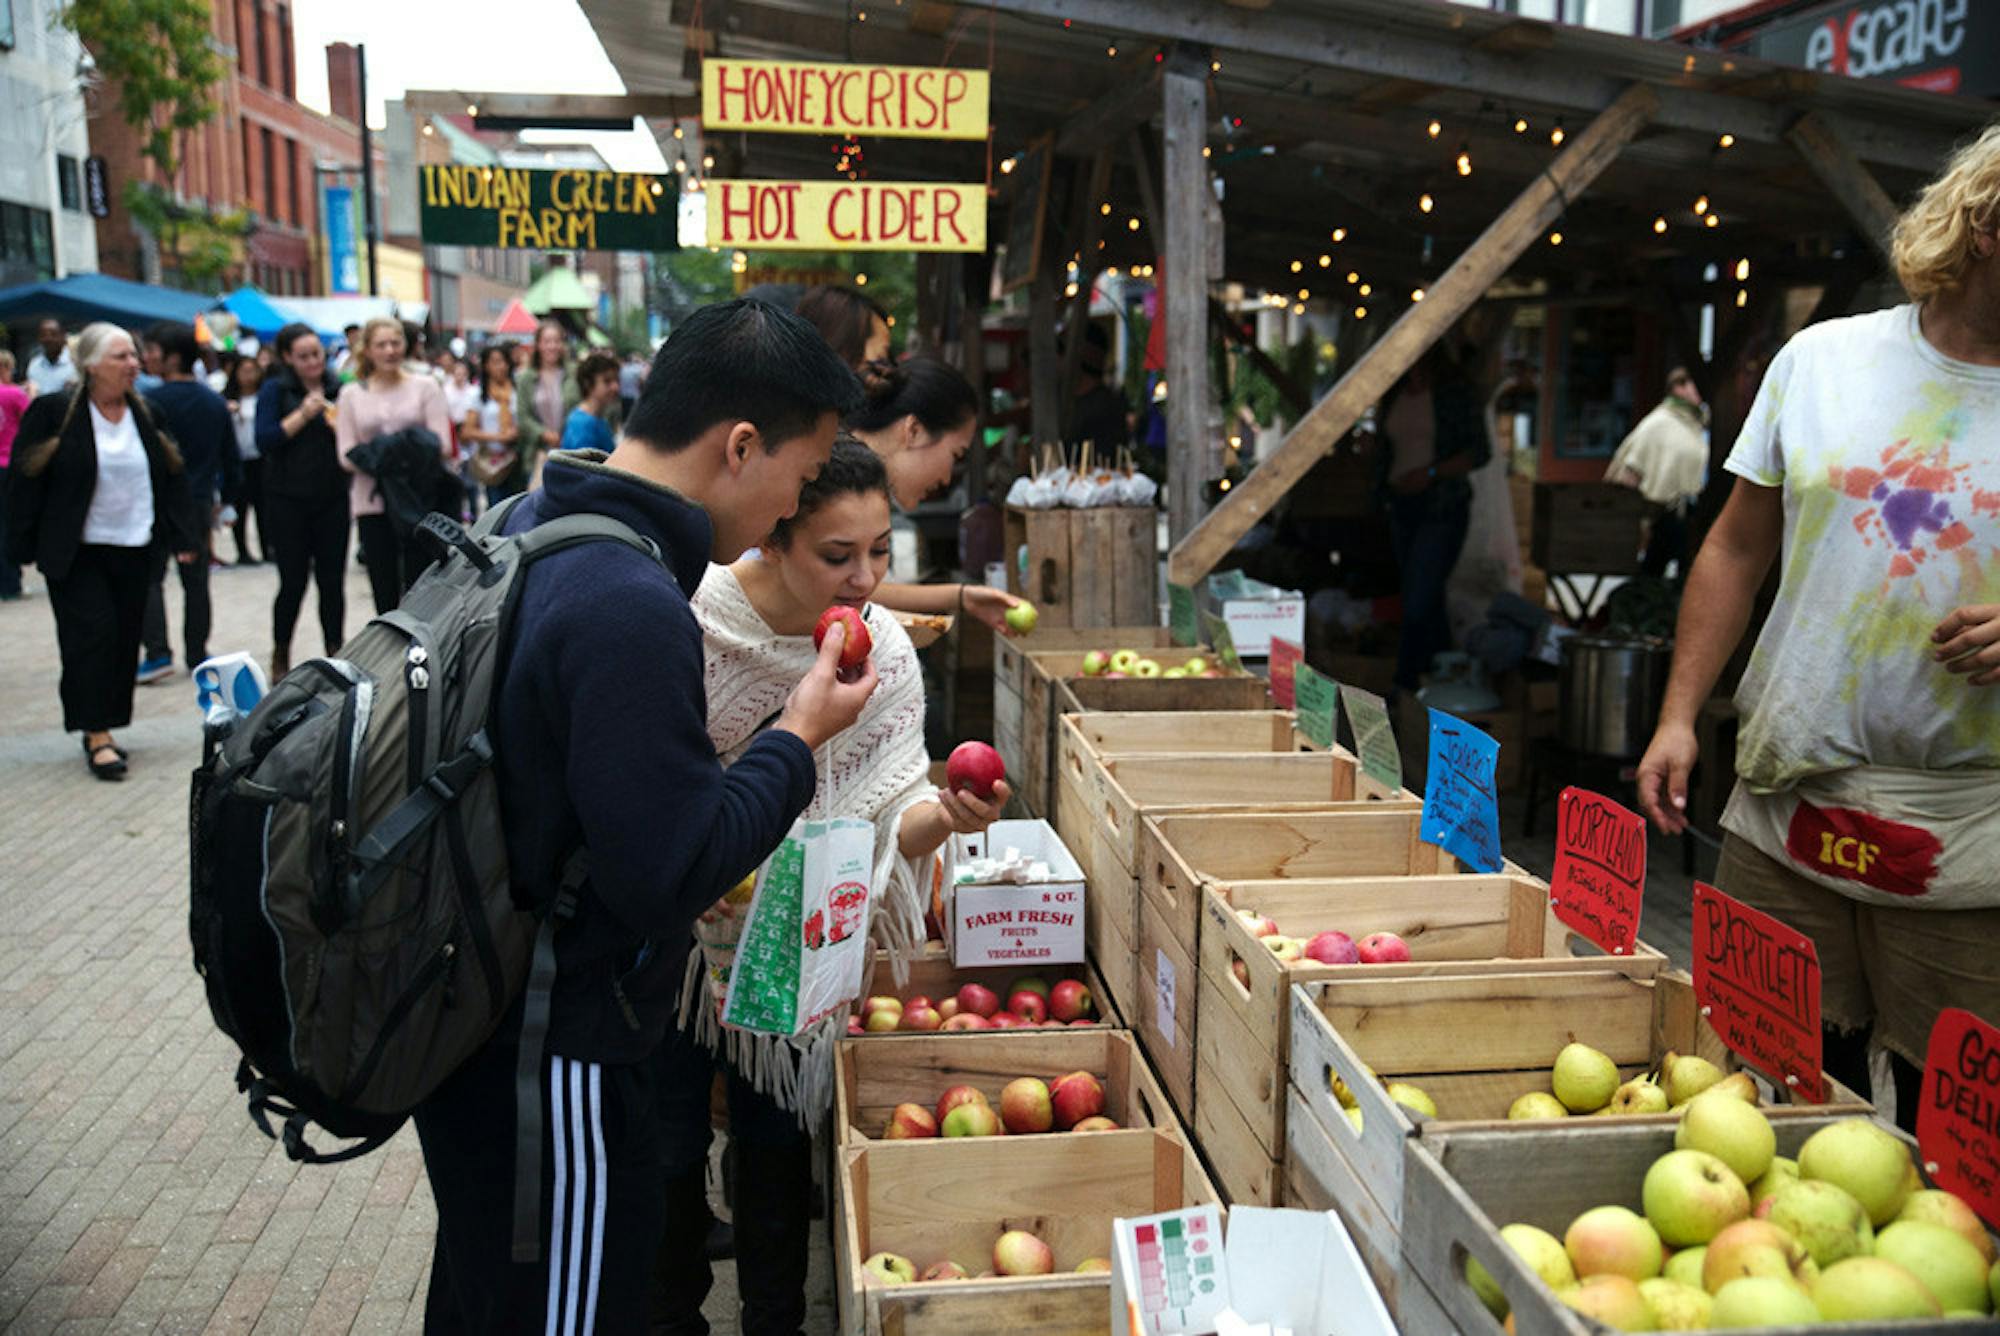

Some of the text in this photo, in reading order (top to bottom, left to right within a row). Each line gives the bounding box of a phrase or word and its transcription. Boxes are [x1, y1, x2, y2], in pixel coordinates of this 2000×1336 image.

[718, 66, 968, 130] HONEYCRISP
[423, 164, 657, 214] INDIAN CREEK
[500, 208, 597, 249] FARM
[721, 184, 968, 244] HOT CIDER
[1565, 796, 1644, 883] CORTLAND
[1819, 831, 1881, 875] ICF
[1042, 892, 1077, 902] 8 QT.
[965, 910, 1074, 929] FARM FRESH
[1000, 928, 1038, 937] FRUITS
[987, 947, 1051, 960] VEGETABLES
[1015, 938, 1023, 947] &
[1703, 899, 1818, 1026] BARTLETT
[1959, 1028, 2000, 1086] GO
